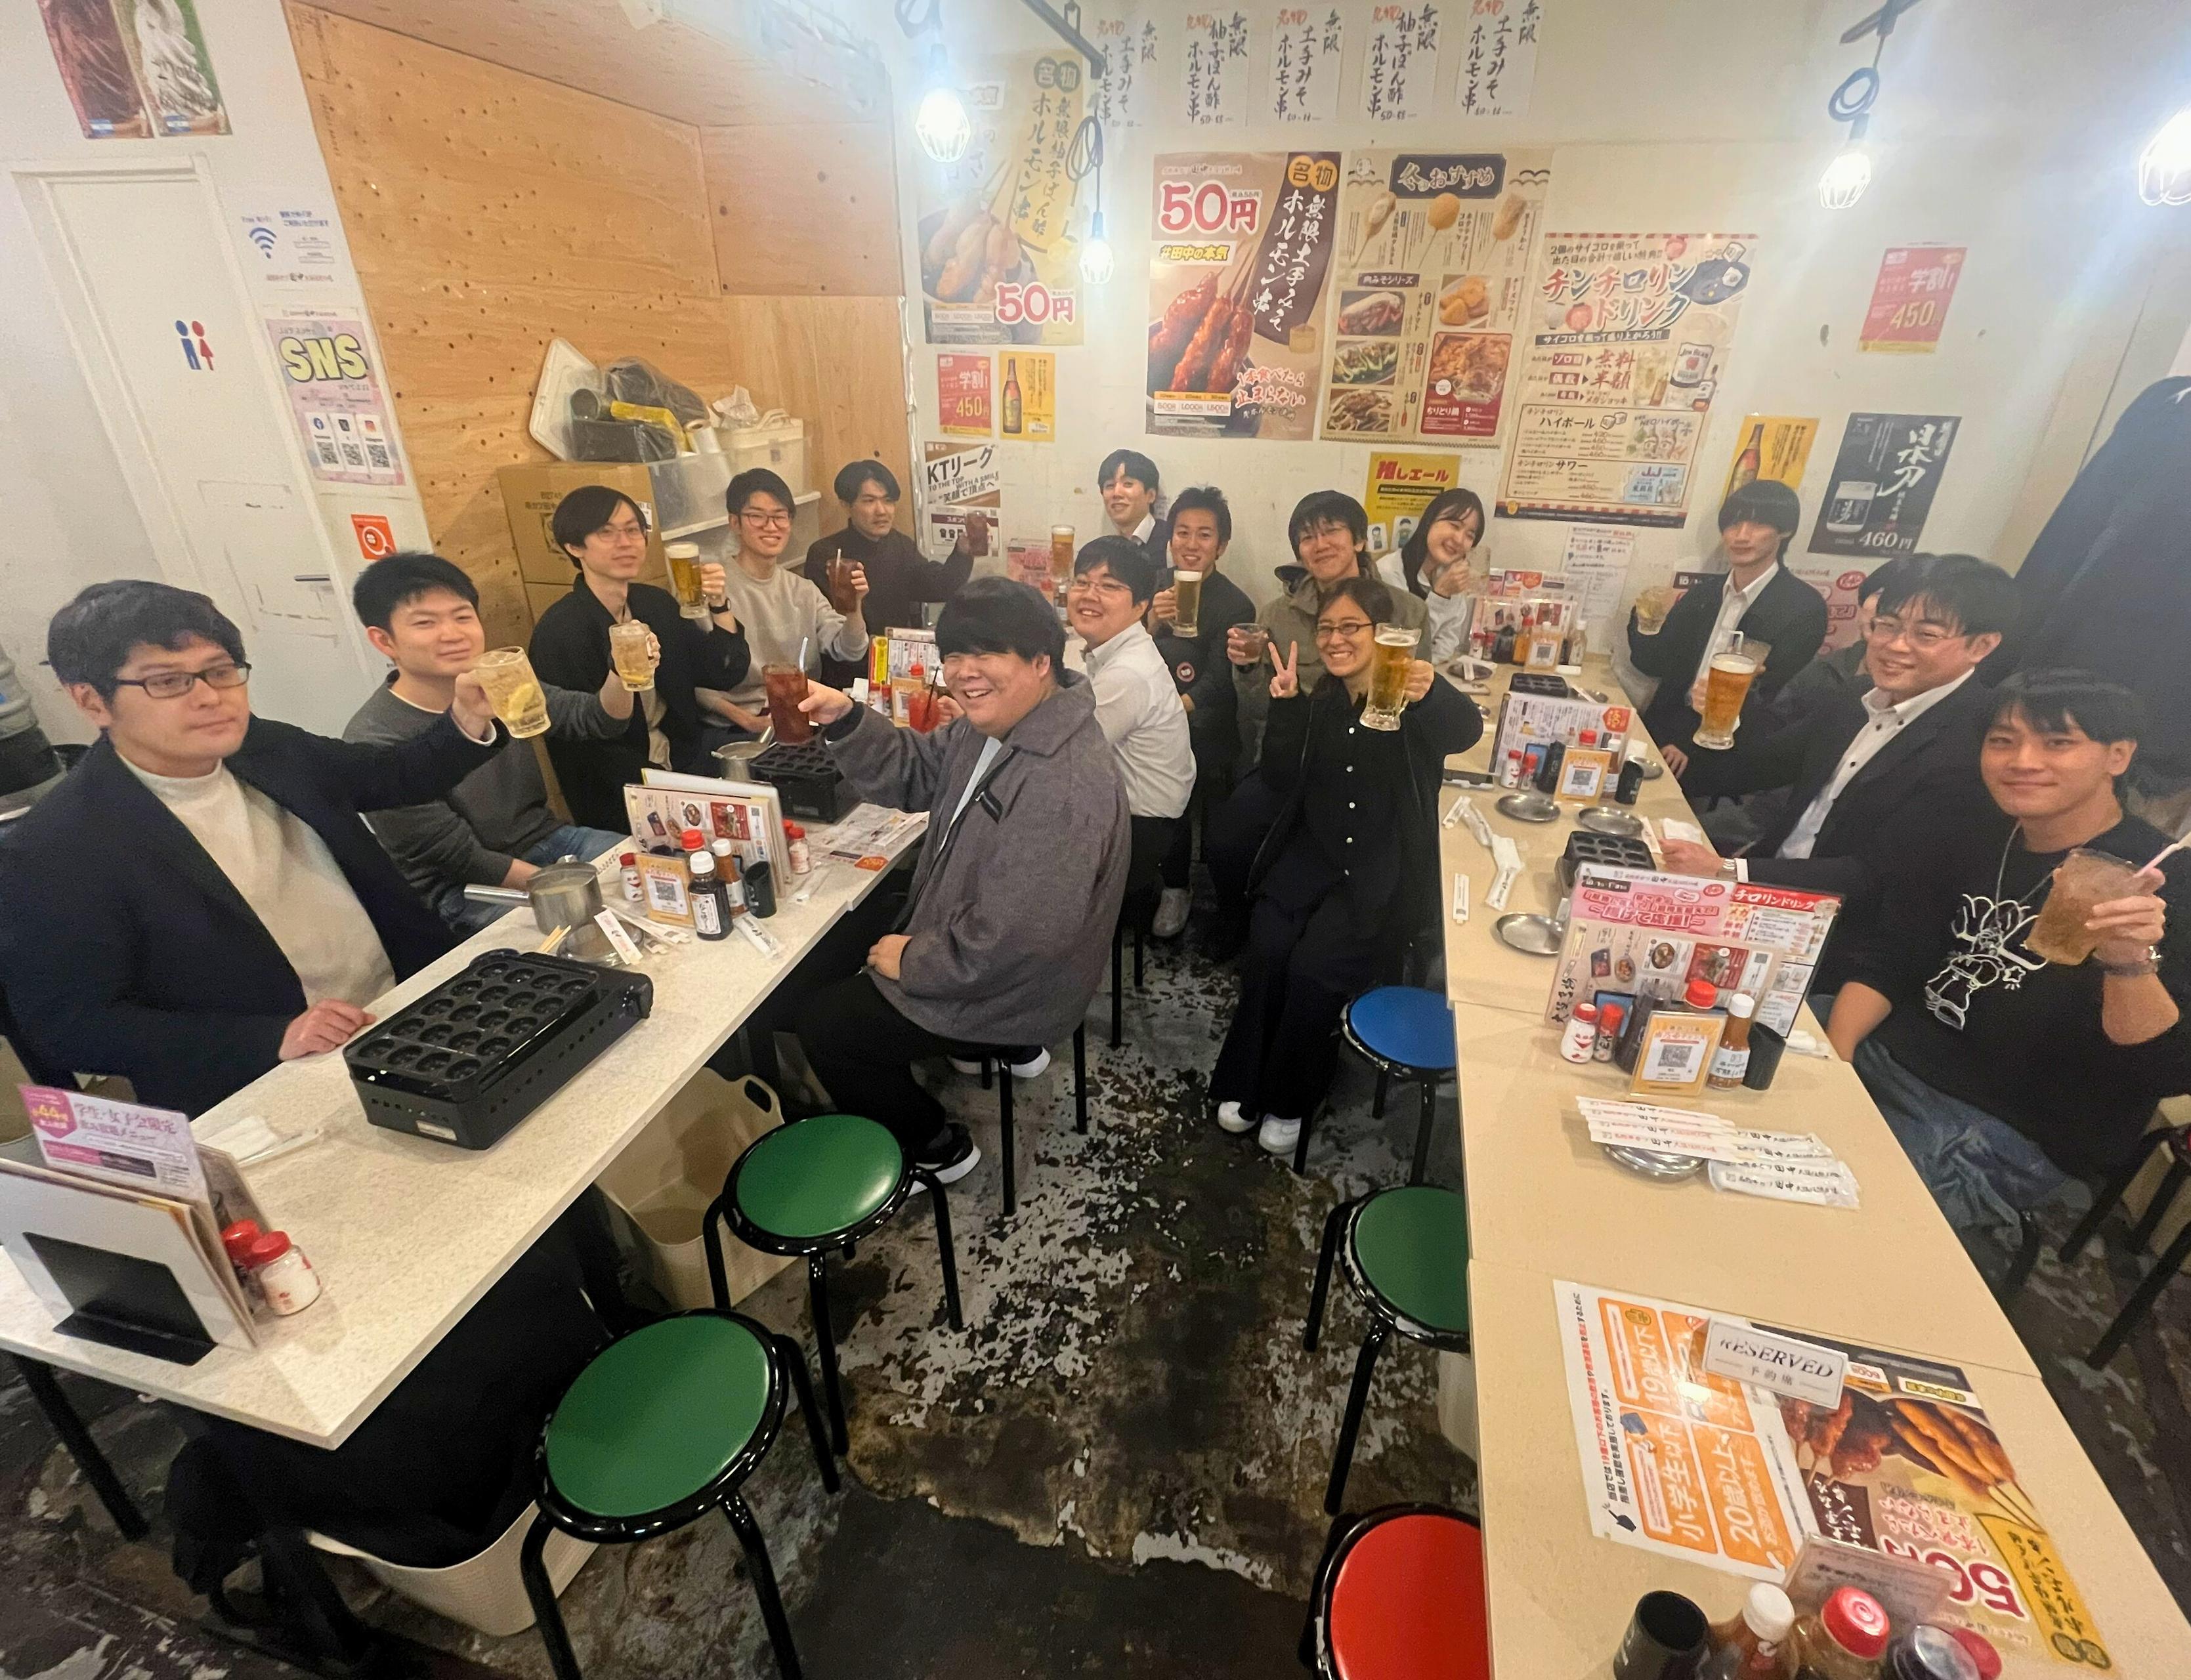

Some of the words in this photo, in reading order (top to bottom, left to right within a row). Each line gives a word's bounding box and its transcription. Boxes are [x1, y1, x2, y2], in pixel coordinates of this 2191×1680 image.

[1229, 12, 1247, 58] 無限
[1323, 9, 1342, 54] 無限
[1417, 3, 1438, 51] 無限
[1187, 41, 1203, 123] ホルモン串
[1274, 34, 1292, 119] ホルモン串
[1368, 34, 1388, 119] ホルモン串
[1462, 24, 1486, 116] ホルモン串
[1293, 161, 1333, 186] 名物
[1160, 184, 1258, 231] 50円
[1542, 263, 1697, 301] チンチロリン
[997, 284, 1074, 324] 50円
[1596, 294, 1691, 331] ドリンク
[279, 333, 370, 383] SNS
[1237, 366, 1305, 387] 1本食べたら
[1594, 348, 1635, 369] 無料
[1235, 386, 1305, 408] 止まらない
[1590, 371, 1630, 390] 半額
[1539, 417, 1596, 429] ハイボール
[927, 444, 996, 485] KTリーグ
[938, 481, 950, 490] THE
[952, 476, 965, 484] TOP
[1556, 461, 1588, 471] サワー
[1634, 1324, 1671, 1404] 19歳以下
[1720, 1339, 1833, 1377] RESERVED
[1659, 1423, 1706, 1542] 小学生以下
[1711, 1436, 1762, 1547] 20歳以上
